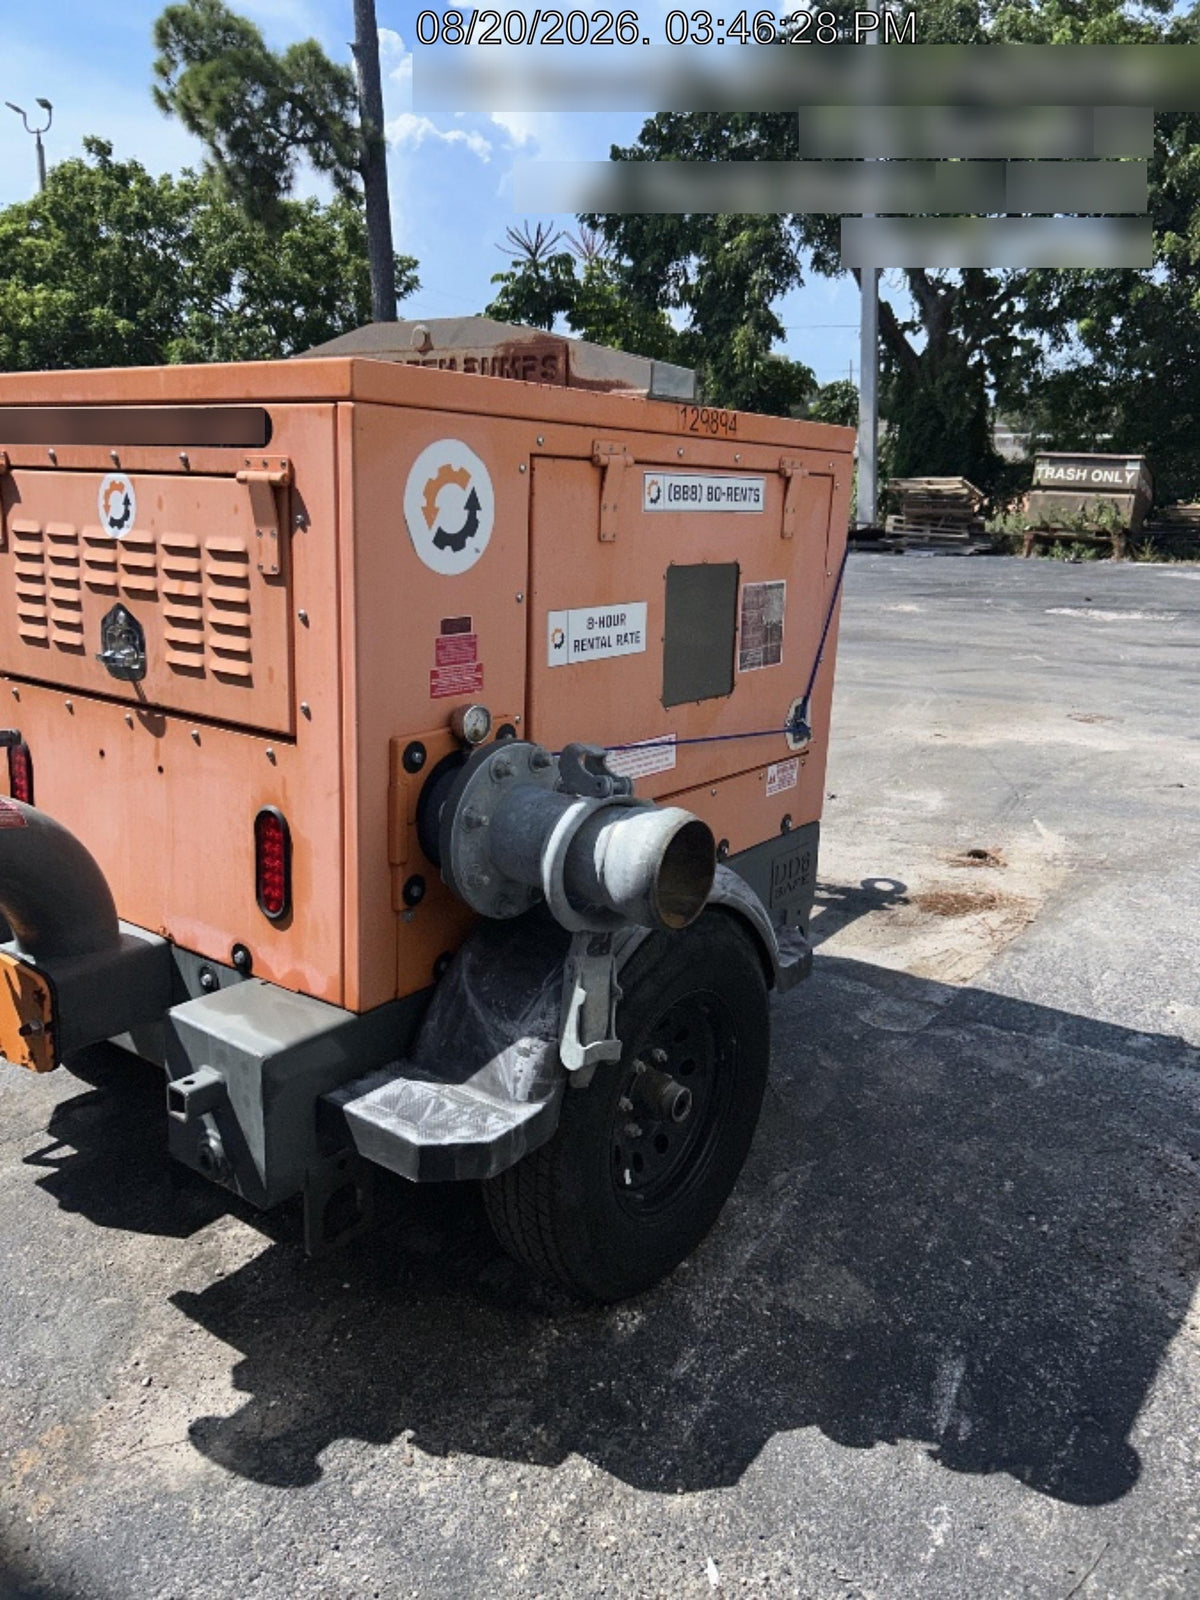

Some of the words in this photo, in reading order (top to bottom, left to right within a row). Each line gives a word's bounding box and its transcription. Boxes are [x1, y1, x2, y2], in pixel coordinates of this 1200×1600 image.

[680, 406, 738, 436] 129894
[1035, 466, 1087, 481] TRASH
[1091, 468, 1136, 484] ONLY
[668, 483, 703, 503] (888)
[586, 612, 627, 630] 8-HOUR
[573, 635, 613, 653] RENTAL
[616, 630, 641, 647] RATE
